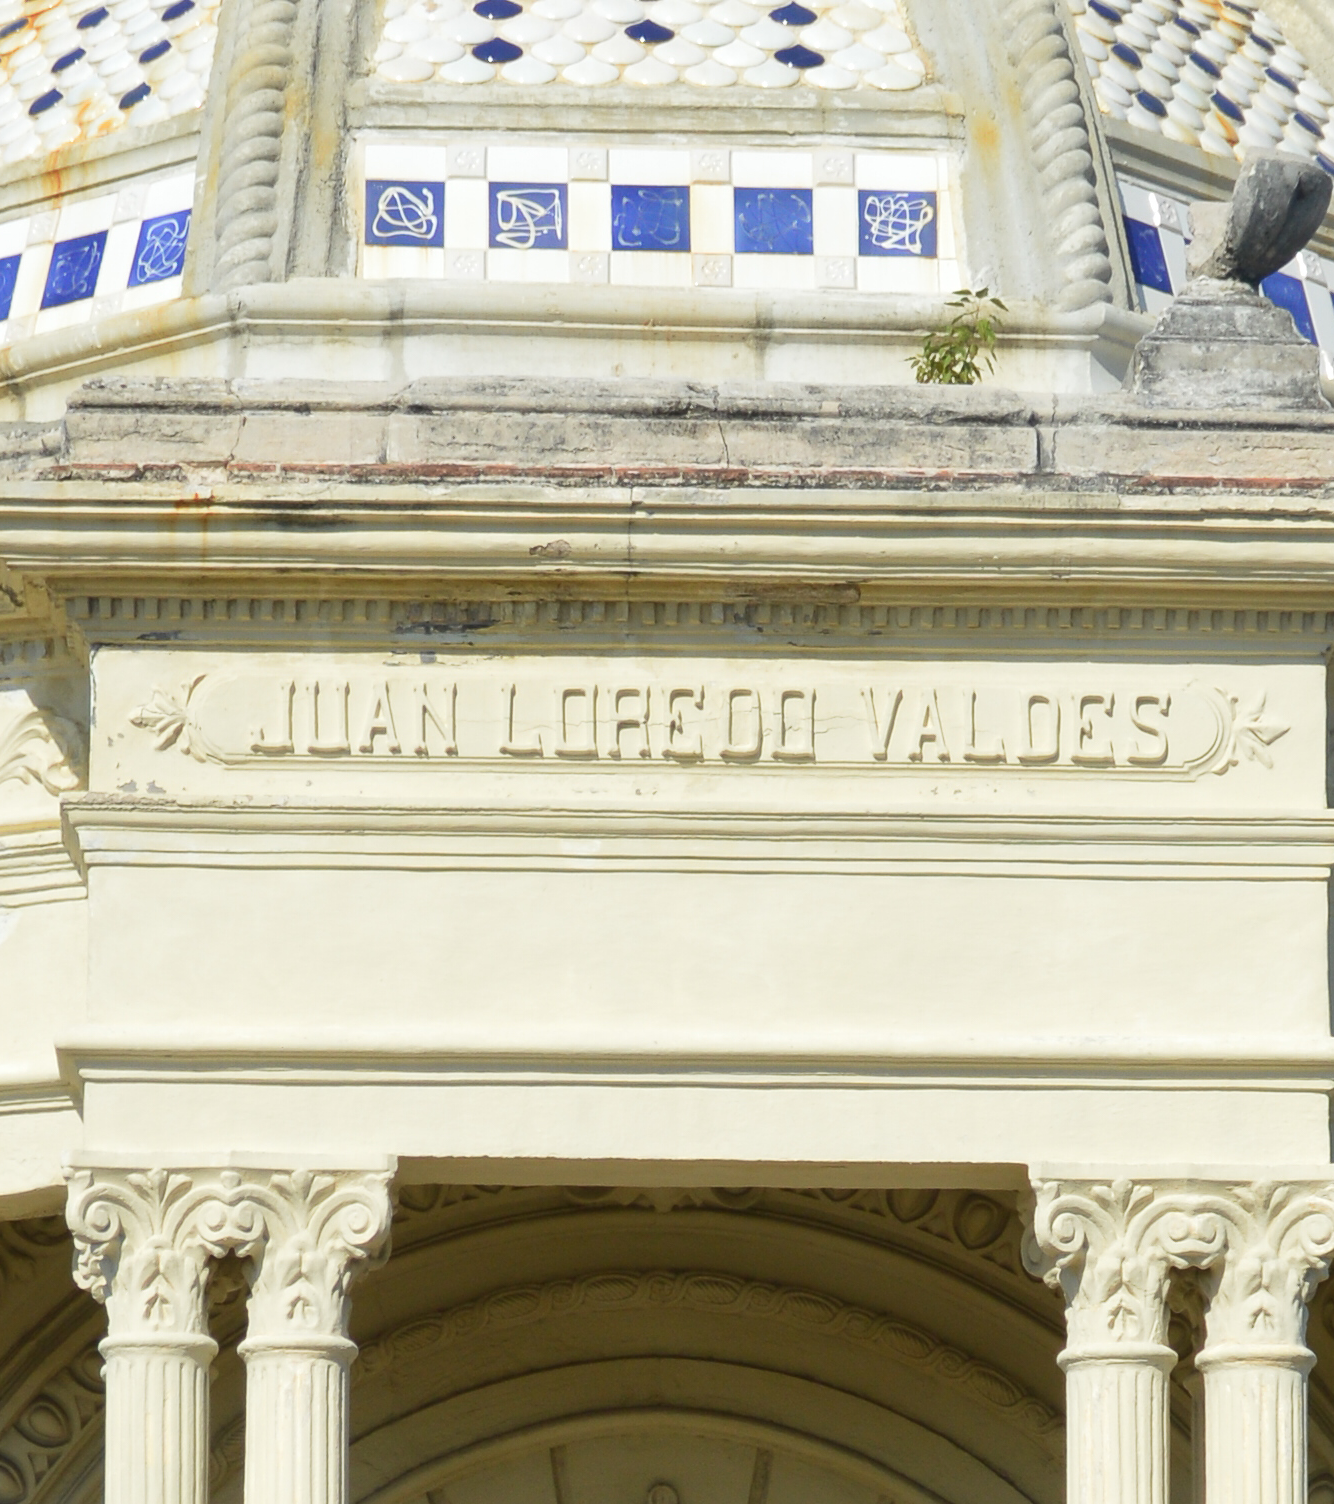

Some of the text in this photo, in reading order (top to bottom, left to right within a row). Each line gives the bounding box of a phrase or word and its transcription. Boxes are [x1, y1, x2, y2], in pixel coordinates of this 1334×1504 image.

[250, 680, 1172, 765] JUAN LOREDO VALDES
